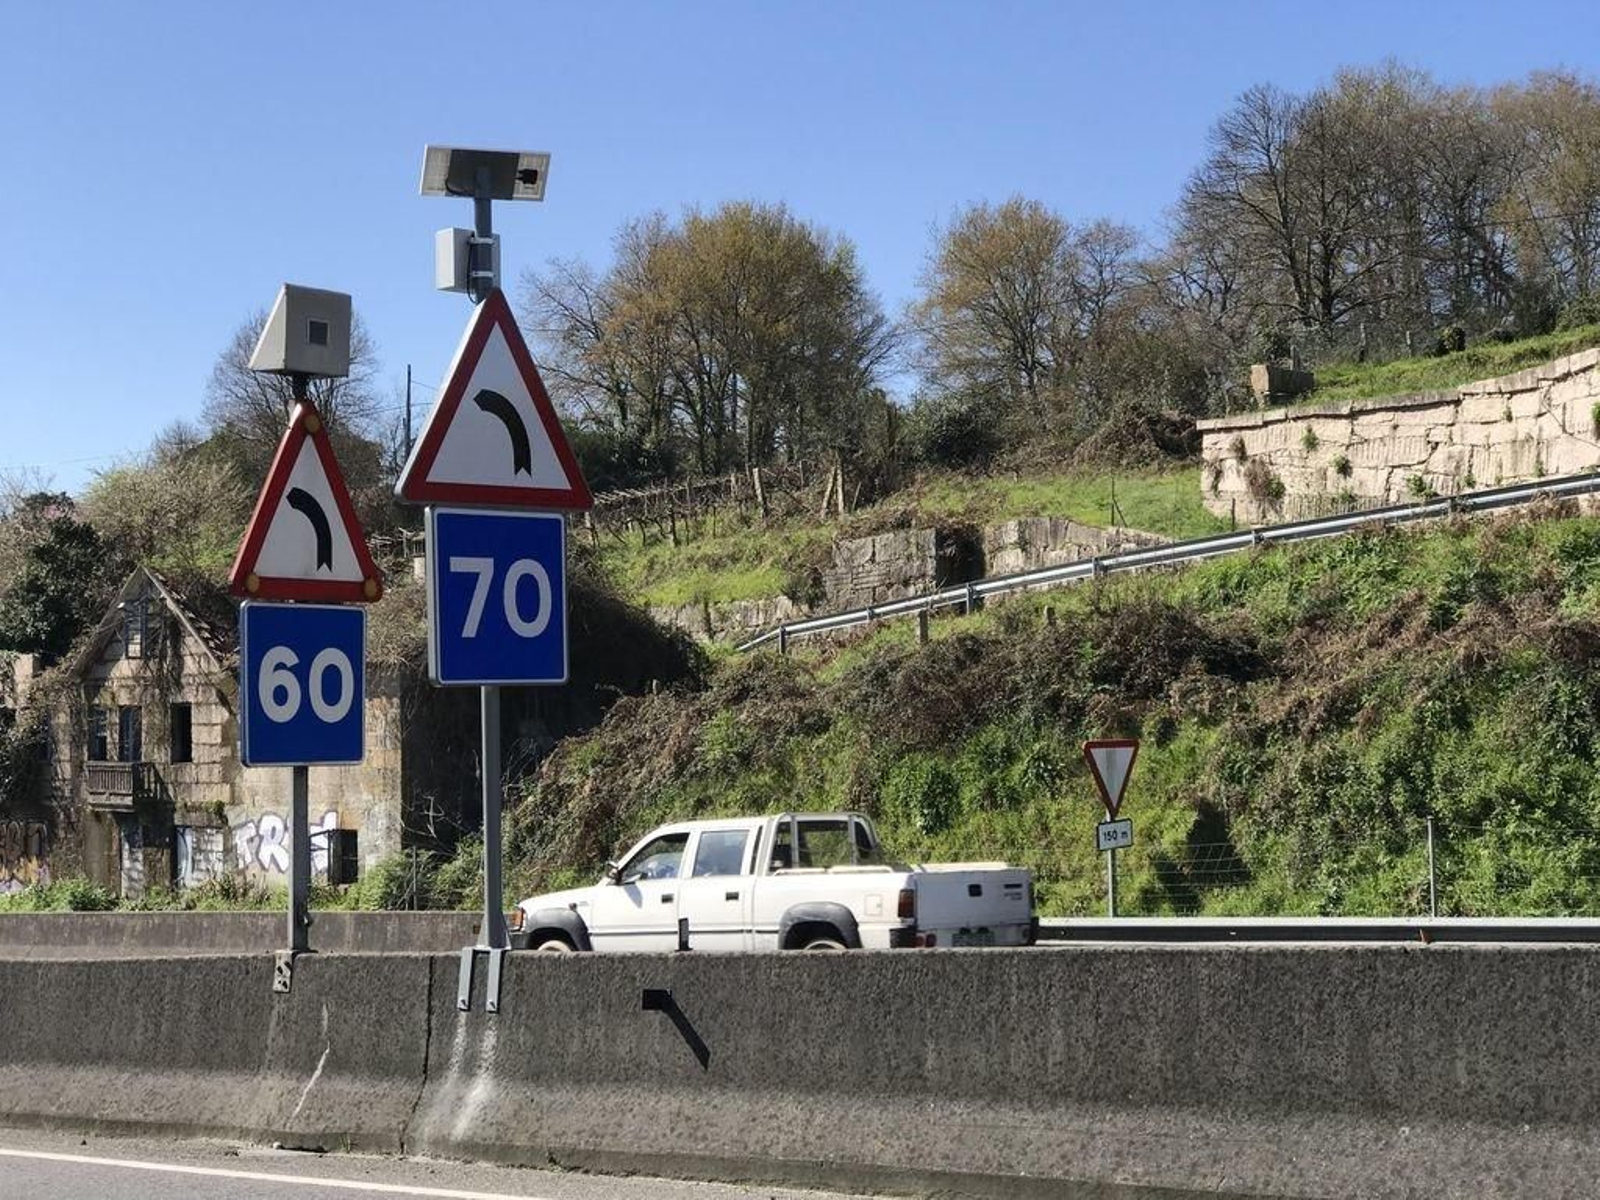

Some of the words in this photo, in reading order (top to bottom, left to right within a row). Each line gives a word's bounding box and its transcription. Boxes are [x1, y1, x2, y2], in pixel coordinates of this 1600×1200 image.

[449, 556, 552, 639] 70
[258, 645, 355, 724] 60
[1103, 829, 1118, 842] 150
